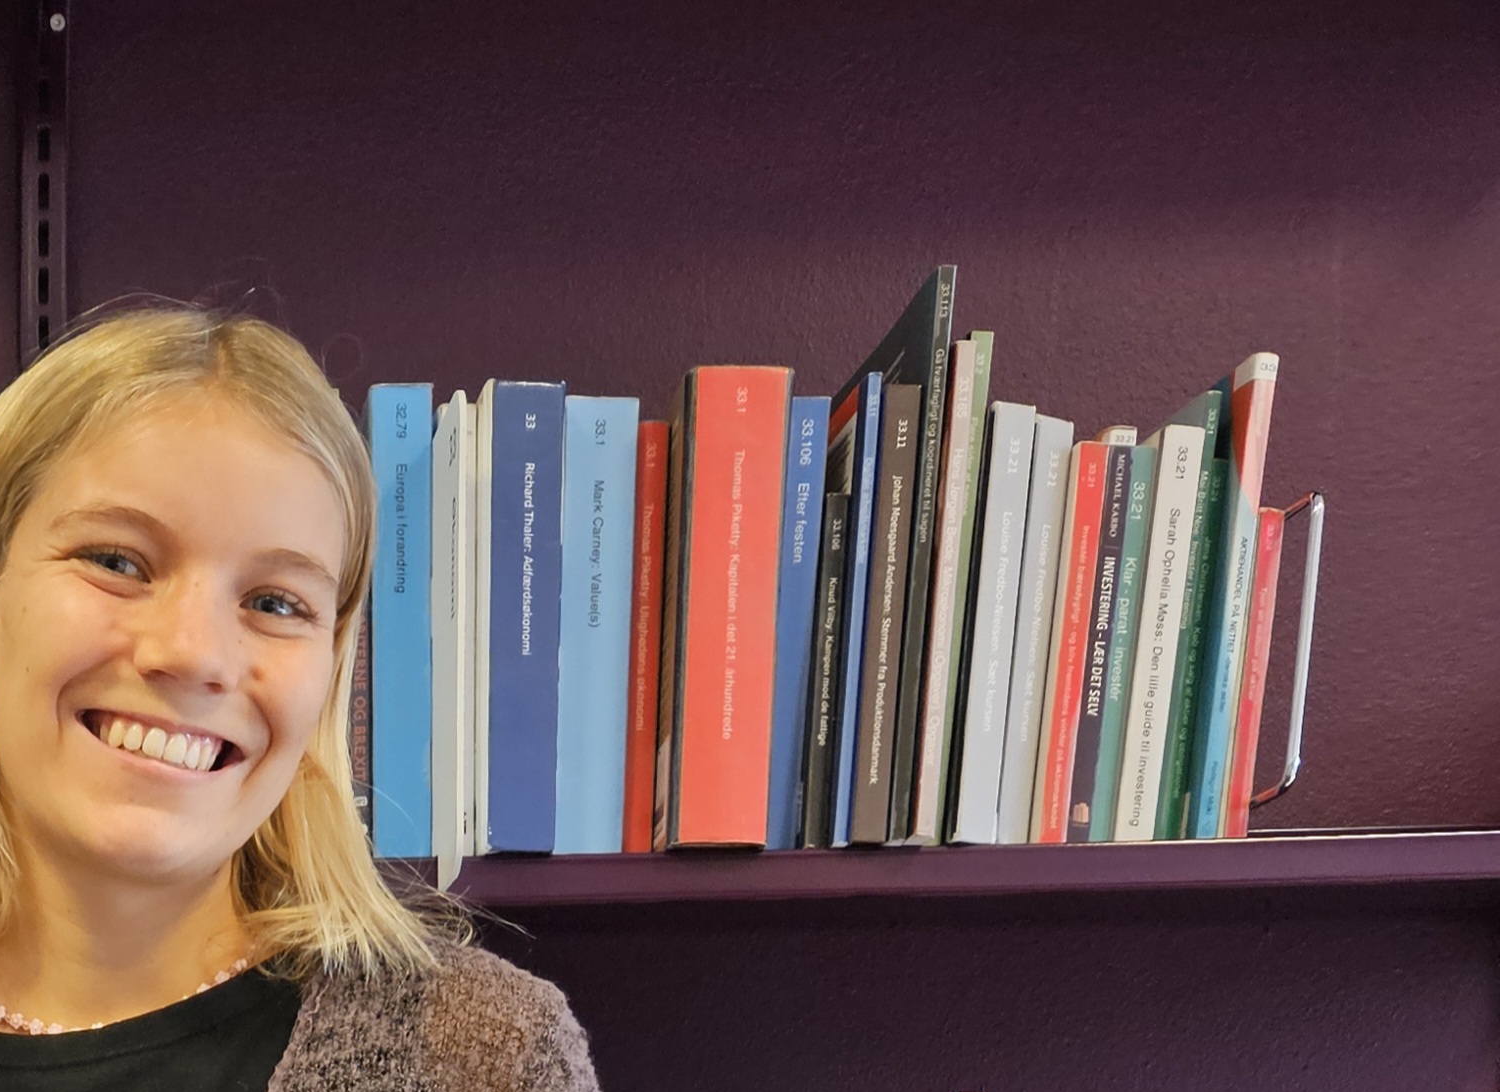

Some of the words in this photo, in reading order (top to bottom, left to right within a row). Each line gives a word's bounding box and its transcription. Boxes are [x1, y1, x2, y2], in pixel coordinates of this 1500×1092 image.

[395, 402, 407, 439] 32.79
[525, 413, 536, 429] 33
[594, 419, 607, 445] 33.1
[896, 419, 909, 449] 33.11
[799, 419, 815, 465] 33.106
[1112, 453, 1126, 499] MICHAEL
[1174, 446, 1189, 480] 33.21
[393, 463, 408, 512] Europa
[524, 463, 536, 508] Richard
[593, 480, 605, 512] Mark
[795, 483, 810, 515] Efter
[892, 475, 905, 504] Johan
[523, 512, 535, 553] Thaler:
[884, 507, 902, 561] Moesgaard
[1108, 502, 1121, 537] KARBO
[1165, 508, 1181, 546] Sarah
[393, 523, 408, 594] forandring
[588, 517, 604, 568] Carney:
[791, 518, 807, 563] festen
[1094, 556, 1115, 629] INVESTERING
[1155, 549, 1176, 600] Ophelia
[522, 555, 534, 656] Adfærdsøkonomi
[587, 574, 602, 628] Value(s)
[878, 617, 893, 663] Stemmer
[1090, 641, 1106, 663] LÆR
[1149, 646, 1164, 671] Den
[877, 666, 888, 680] fra
[1088, 666, 1104, 687] DET
[1146, 675, 1160, 697] lille
[1084, 690, 1101, 717] SELV
[1138, 701, 1157, 737] guide
[868, 682, 887, 785] Produktionsdanmark
[1139, 741, 1151, 752] til
[1127, 756, 1150, 826] investering
